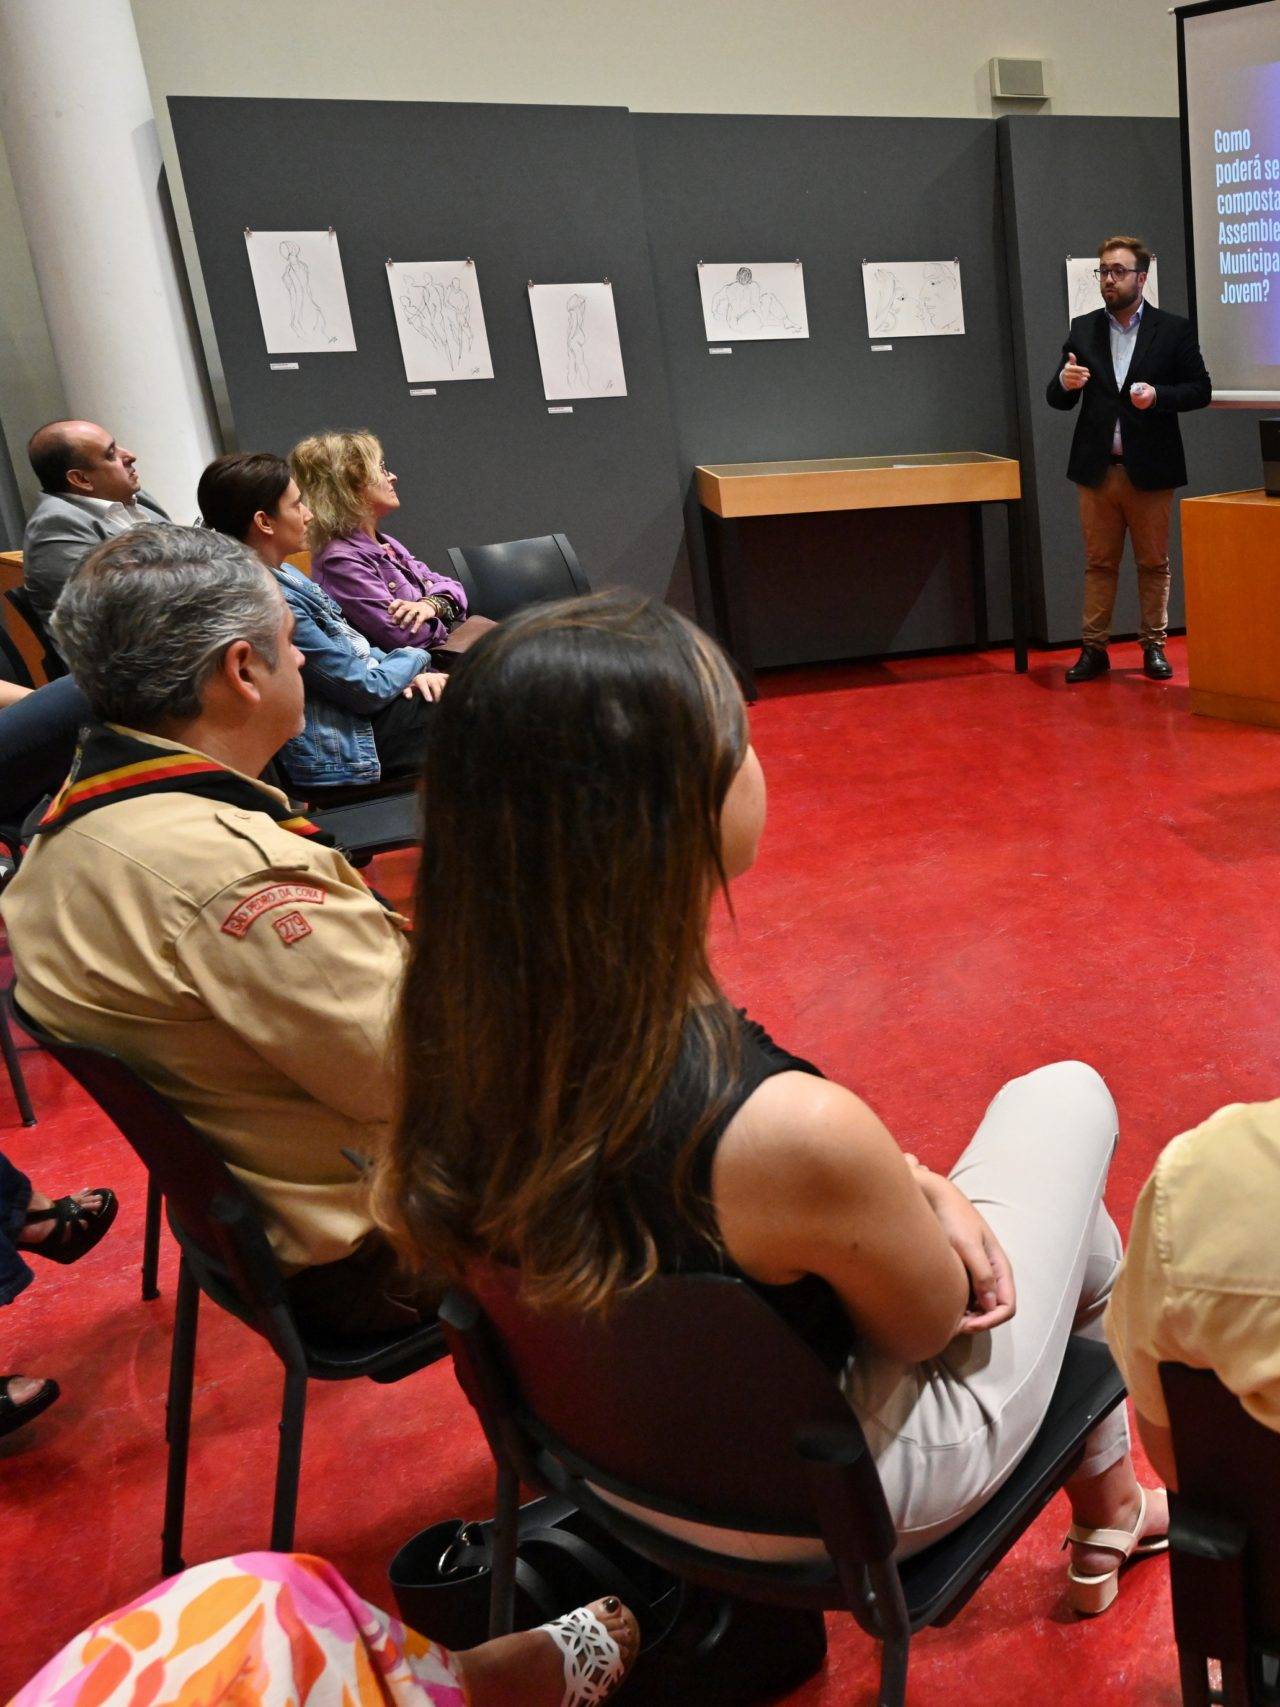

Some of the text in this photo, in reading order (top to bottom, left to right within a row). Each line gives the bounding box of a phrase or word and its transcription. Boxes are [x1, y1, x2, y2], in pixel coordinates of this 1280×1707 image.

[1214, 129, 1251, 153] Como
[1216, 154, 1262, 187] poderá
[1221, 279, 1270, 304] Jovem?
[277, 888, 293, 897] DA
